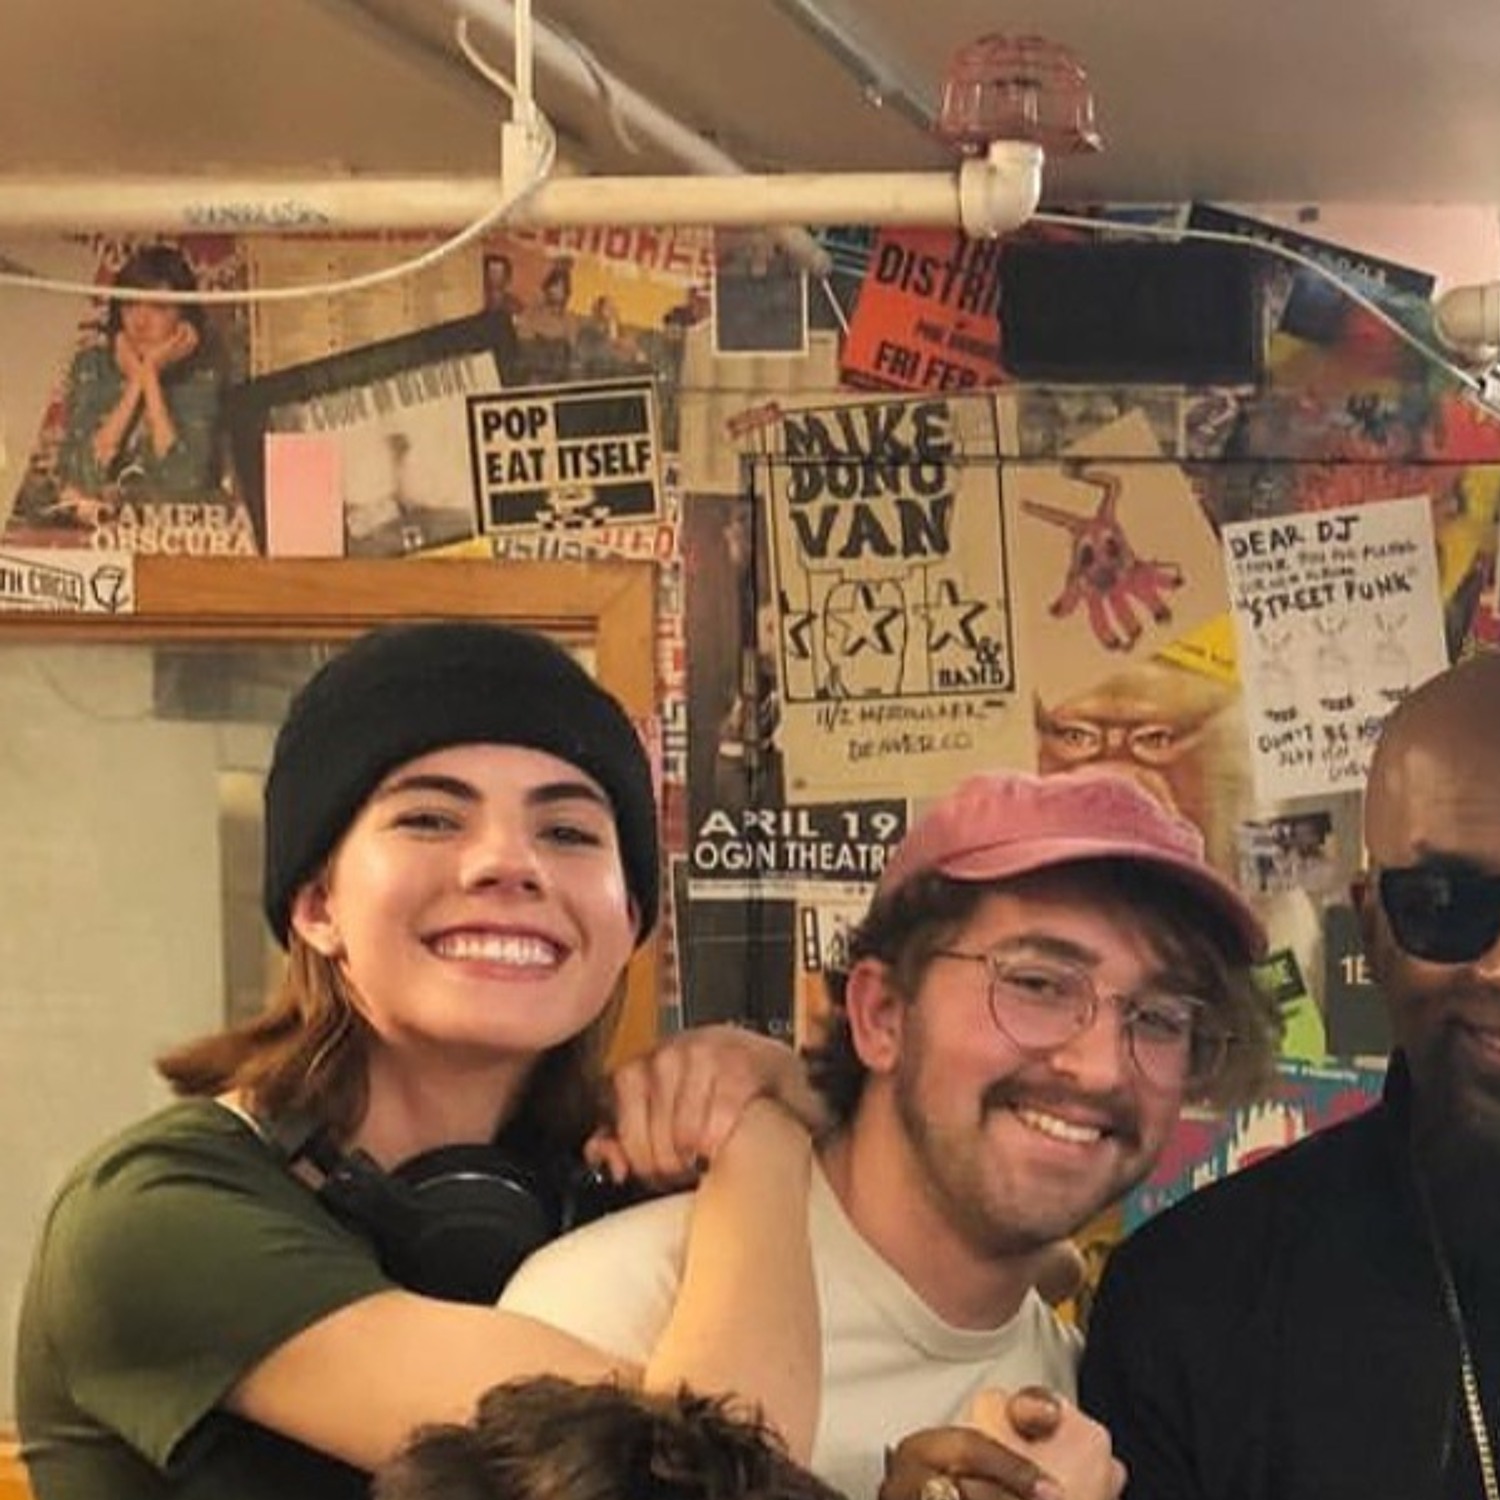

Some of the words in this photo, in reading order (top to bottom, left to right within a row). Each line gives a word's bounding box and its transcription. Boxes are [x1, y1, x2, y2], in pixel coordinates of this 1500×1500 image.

[481, 405, 548, 443] POP
[783, 401, 954, 461] MIKE
[485, 447, 546, 485] EAT
[556, 439, 651, 480] ITSELF
[95, 502, 251, 531] CAMERA
[788, 497, 954, 559] VAN
[1229, 524, 1305, 559] DEAR
[1316, 514, 1361, 544] DJ
[90, 527, 260, 557] OBSCURA
[698, 809, 820, 837] APRIL
[841, 810, 899, 840] 19
